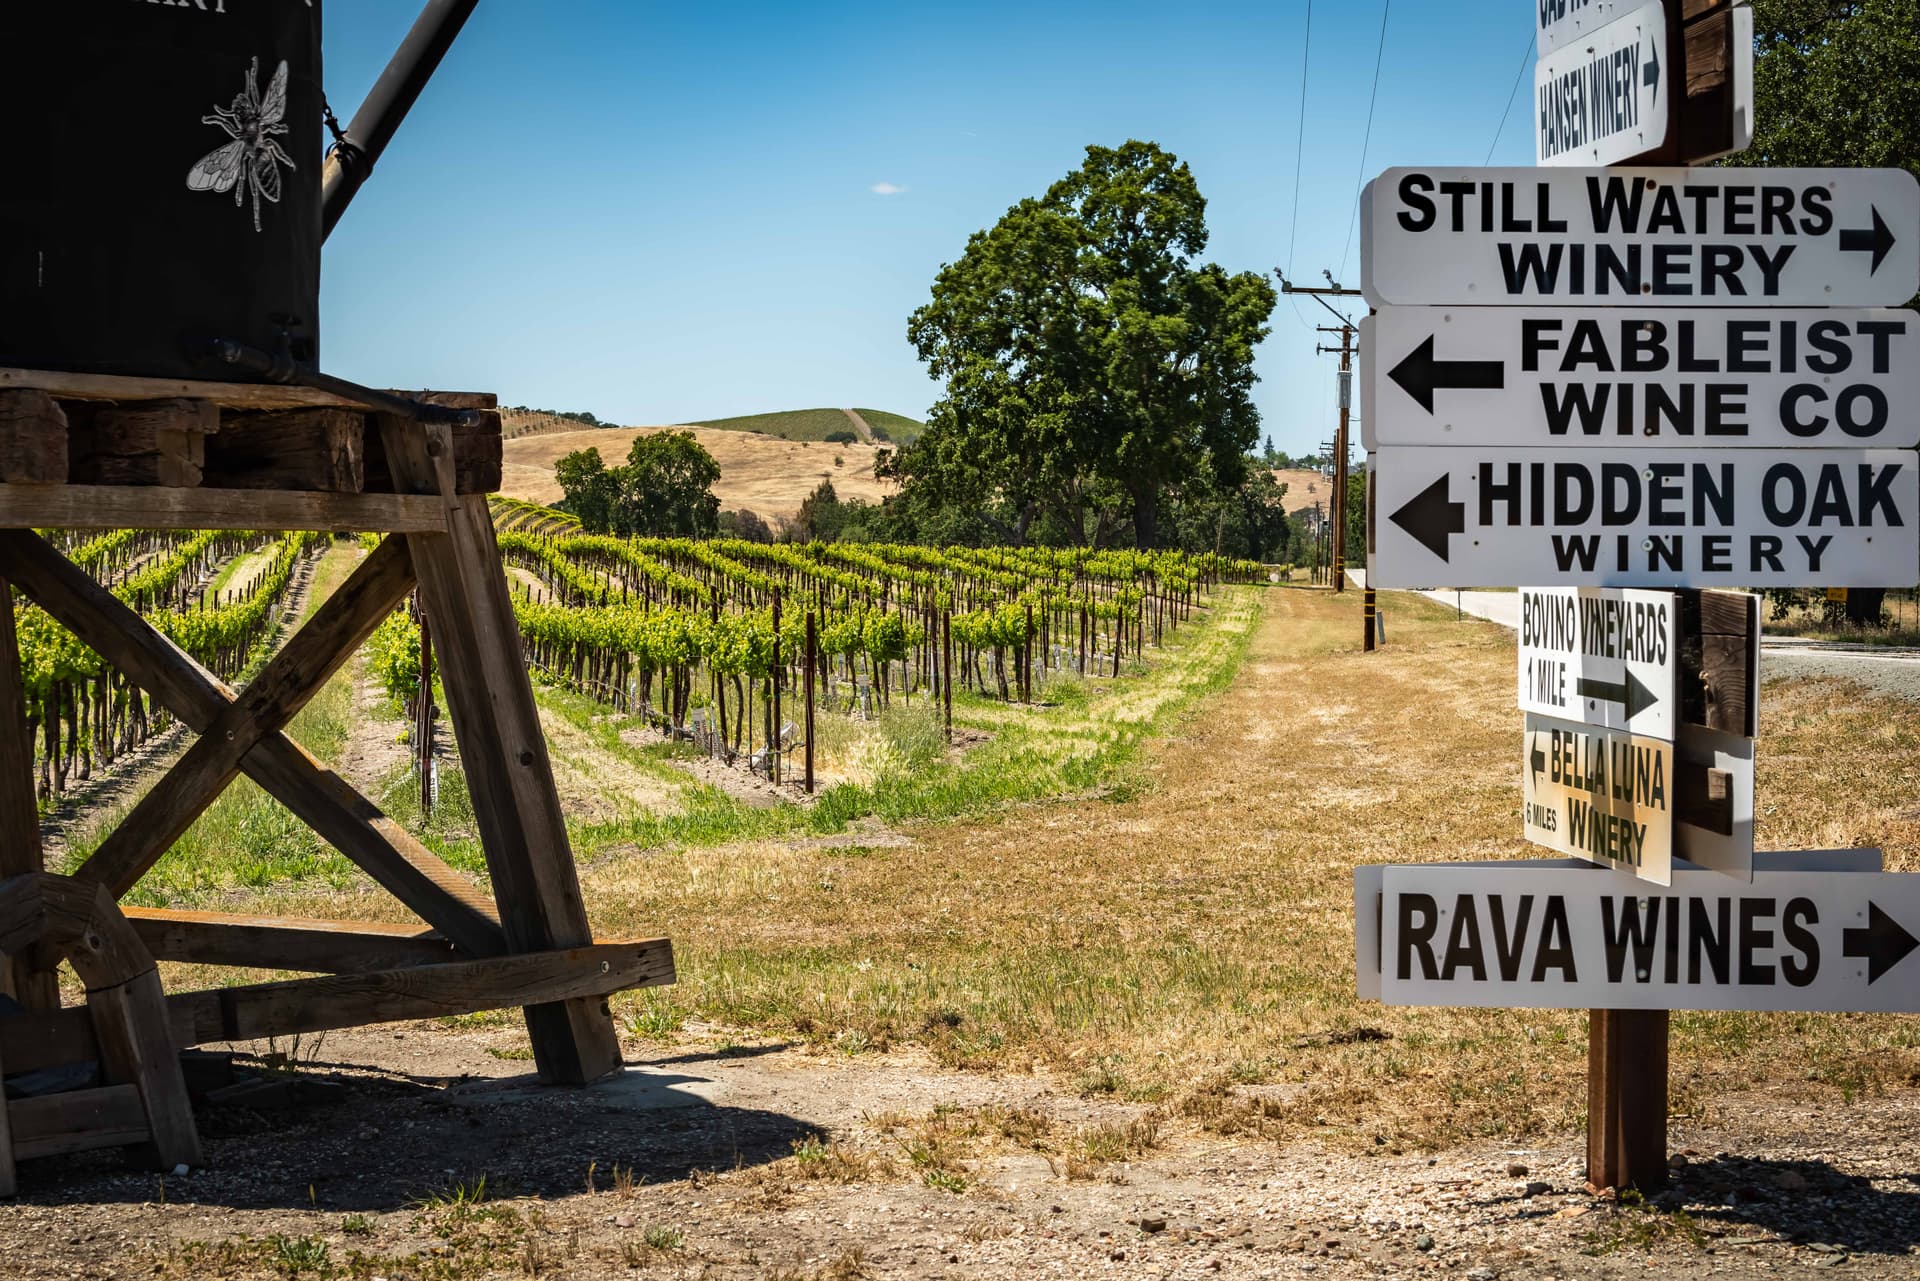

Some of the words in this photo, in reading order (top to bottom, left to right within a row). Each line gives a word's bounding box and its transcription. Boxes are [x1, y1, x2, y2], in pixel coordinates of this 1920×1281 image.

[1540, 65, 1588, 160] HANSEN
[1589, 41, 1640, 141] WINERY
[1396, 173, 1568, 233] STILL
[1585, 176, 1834, 237] WATERS
[1497, 242, 1797, 297] WINERY
[1521, 319, 1907, 375] FABLEIST
[1539, 382, 1749, 437] WINE
[1779, 383, 1889, 438] CO
[1478, 462, 1735, 527] HIDDEN
[1761, 462, 1905, 528] OAK
[1551, 534, 1834, 572] WINERY
[1523, 592, 1576, 653] BOVINO
[1579, 596, 1667, 666] VINEYARDS
[1528, 657, 1533, 701] 1
[1537, 658, 1566, 707] MILE
[1551, 728, 1606, 796] BELLA
[1611, 741, 1666, 811] LUNA
[1526, 801, 1532, 824] 6
[1532, 803, 1557, 833] MILES
[1568, 796, 1647, 868] WINERY
[1397, 892, 1578, 983] RAVA
[1599, 895, 1821, 988] WINES
